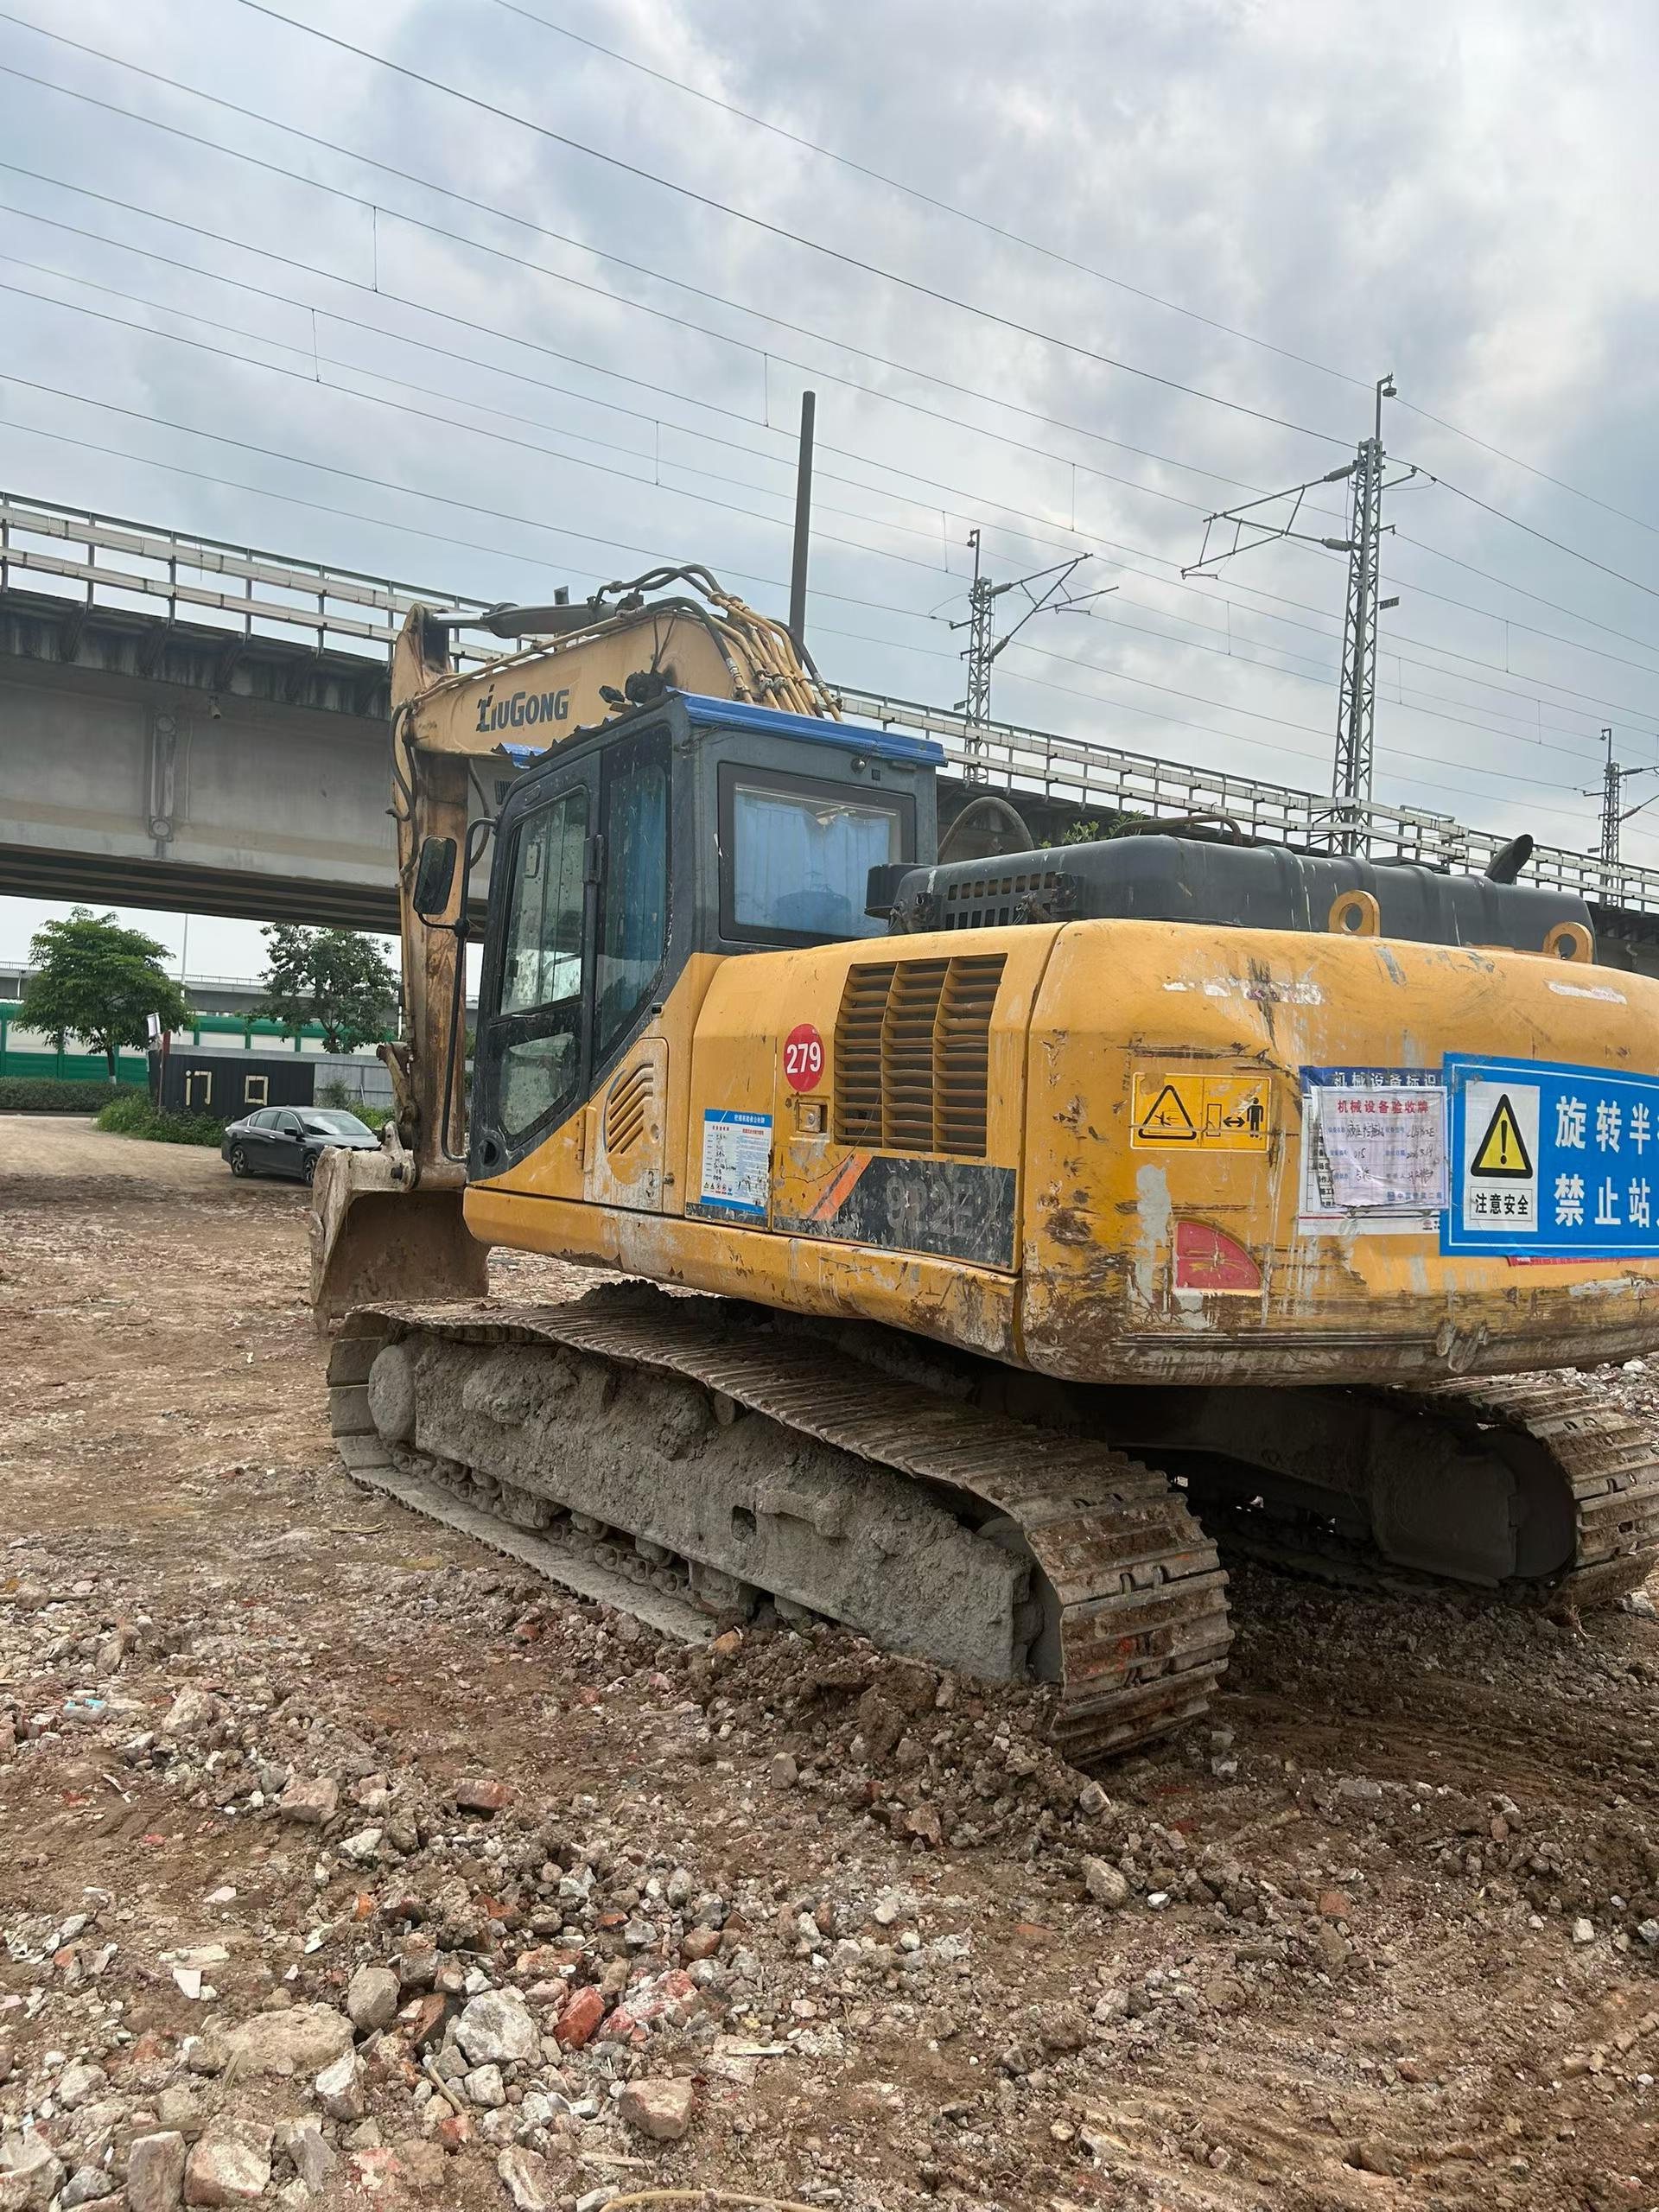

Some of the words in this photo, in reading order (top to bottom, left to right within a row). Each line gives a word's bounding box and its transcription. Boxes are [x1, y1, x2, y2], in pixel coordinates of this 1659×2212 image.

[786, 1042, 821, 1074] 279
[186, 1070, 269, 1106] 门口
[1334, 1071, 1444, 1087] 机械设备标识
[1338, 1100, 1429, 1114] 机械设备验收牌
[1555, 1096, 1659, 1154] 旋转半
[1476, 1192, 1529, 1215] 注意安全
[1554, 1173, 1659, 1228] 禁止站
